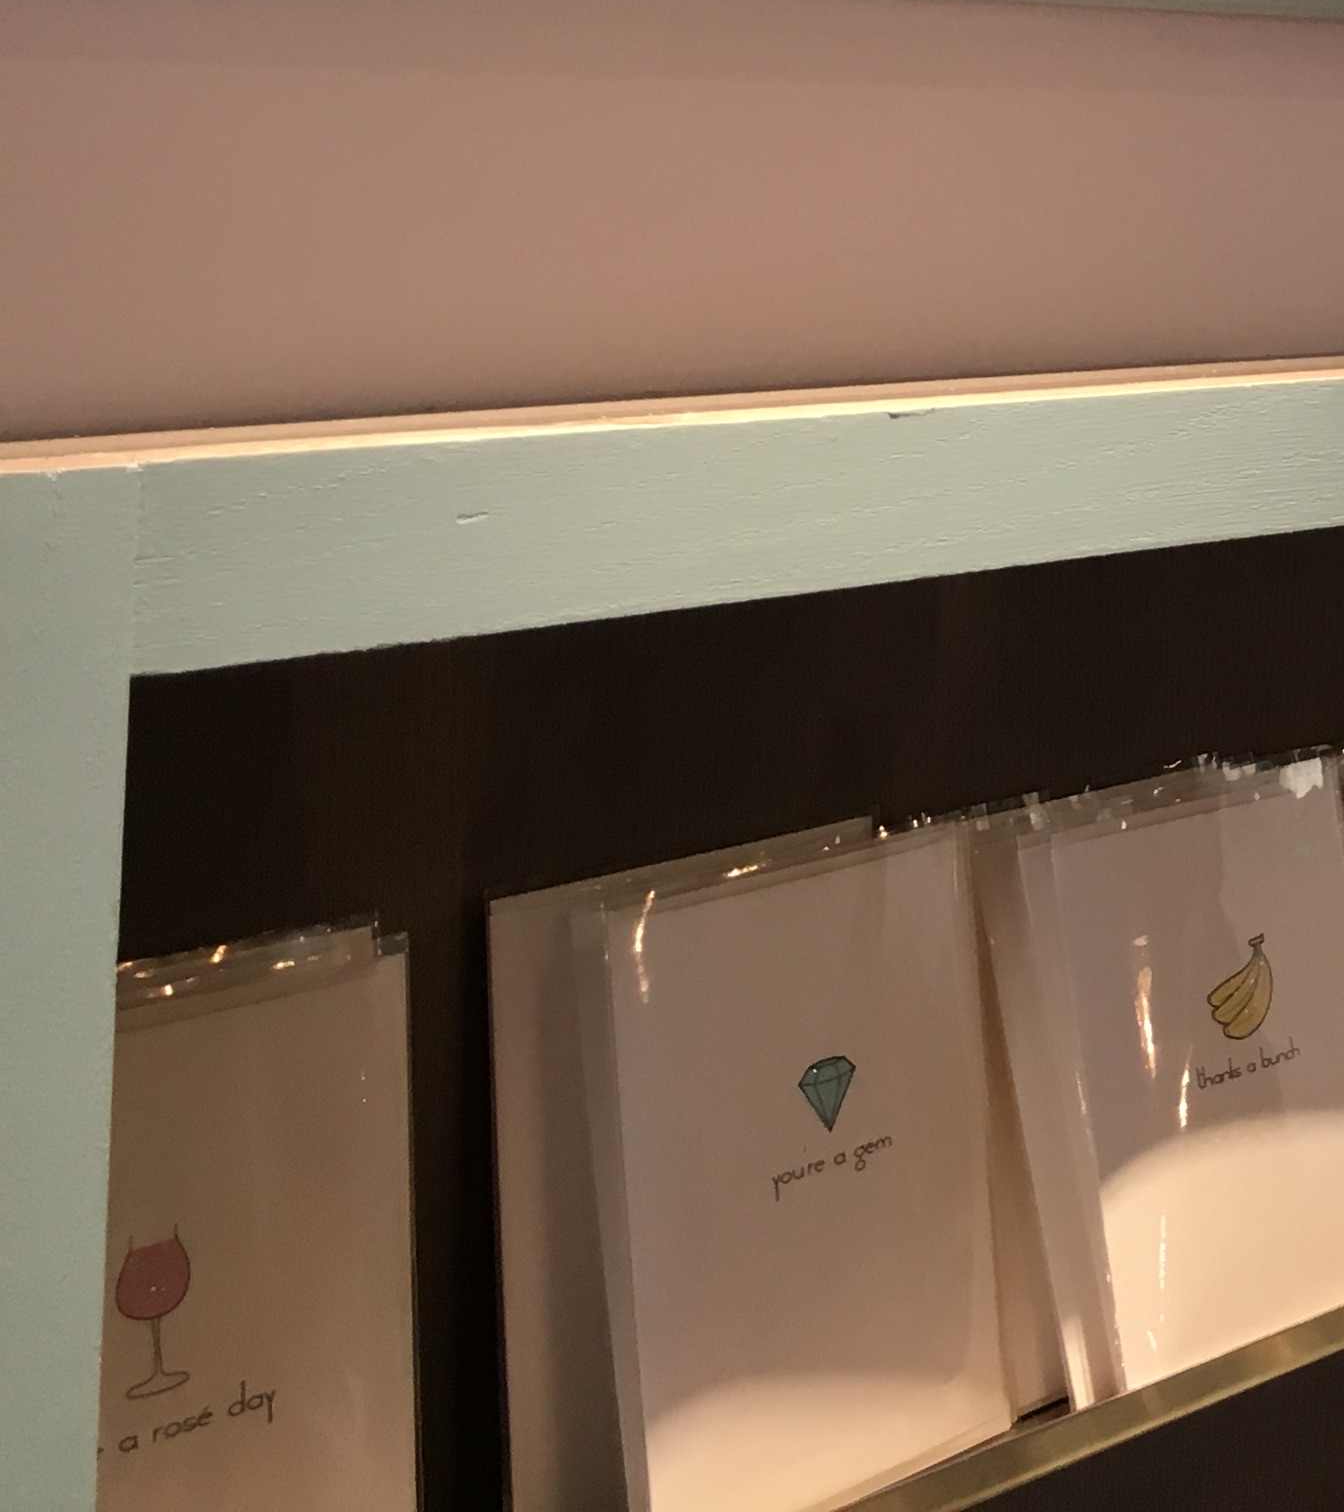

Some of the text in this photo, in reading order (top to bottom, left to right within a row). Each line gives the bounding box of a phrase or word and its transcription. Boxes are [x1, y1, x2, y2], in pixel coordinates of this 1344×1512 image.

[1196, 1035, 1301, 1090] thanks a bunch
[772, 1136, 893, 1202] you're a gem
[118, 1435, 139, 1453] a
[152, 1405, 213, 1443] rosé
[227, 1380, 276, 1424] day
